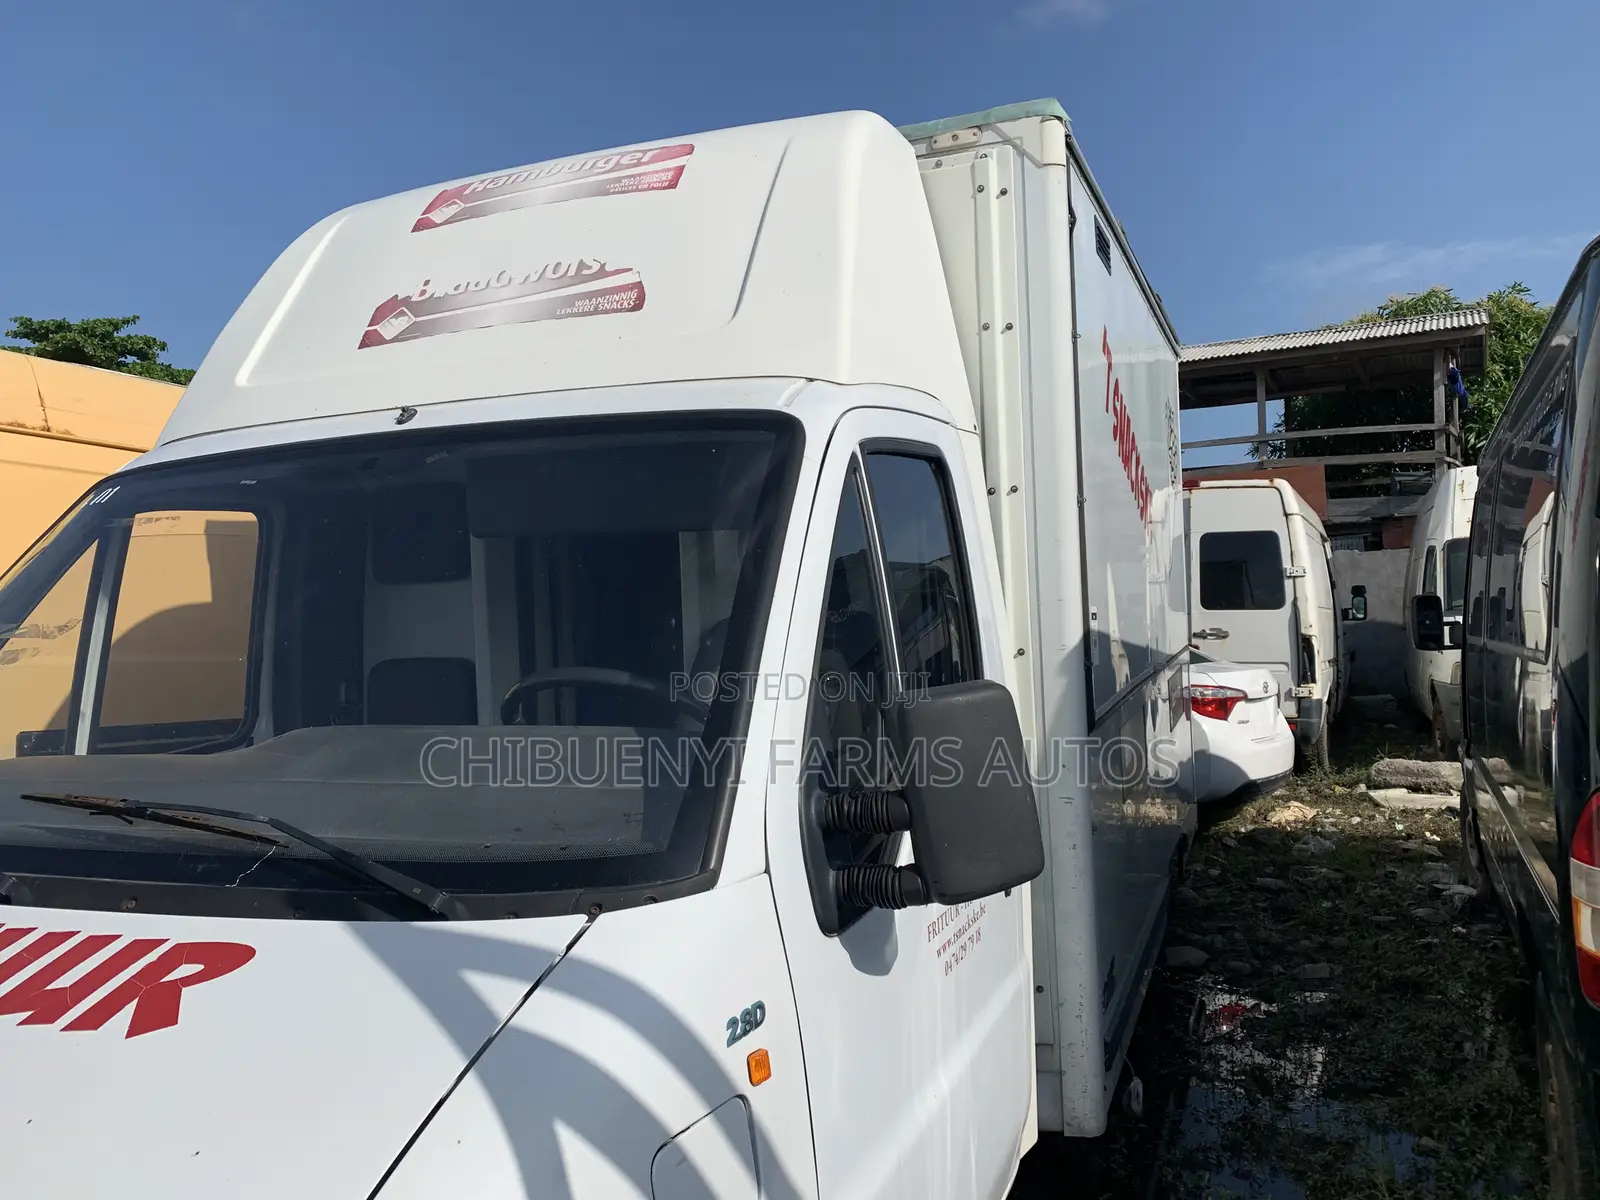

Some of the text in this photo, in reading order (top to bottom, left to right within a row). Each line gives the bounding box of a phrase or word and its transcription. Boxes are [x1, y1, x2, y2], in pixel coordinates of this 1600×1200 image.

[463, 150, 660, 195] Hamburger
[556, 299, 635, 315] LEKKERE SNACKS
[574, 289, 638, 307] WAANZINNIG
